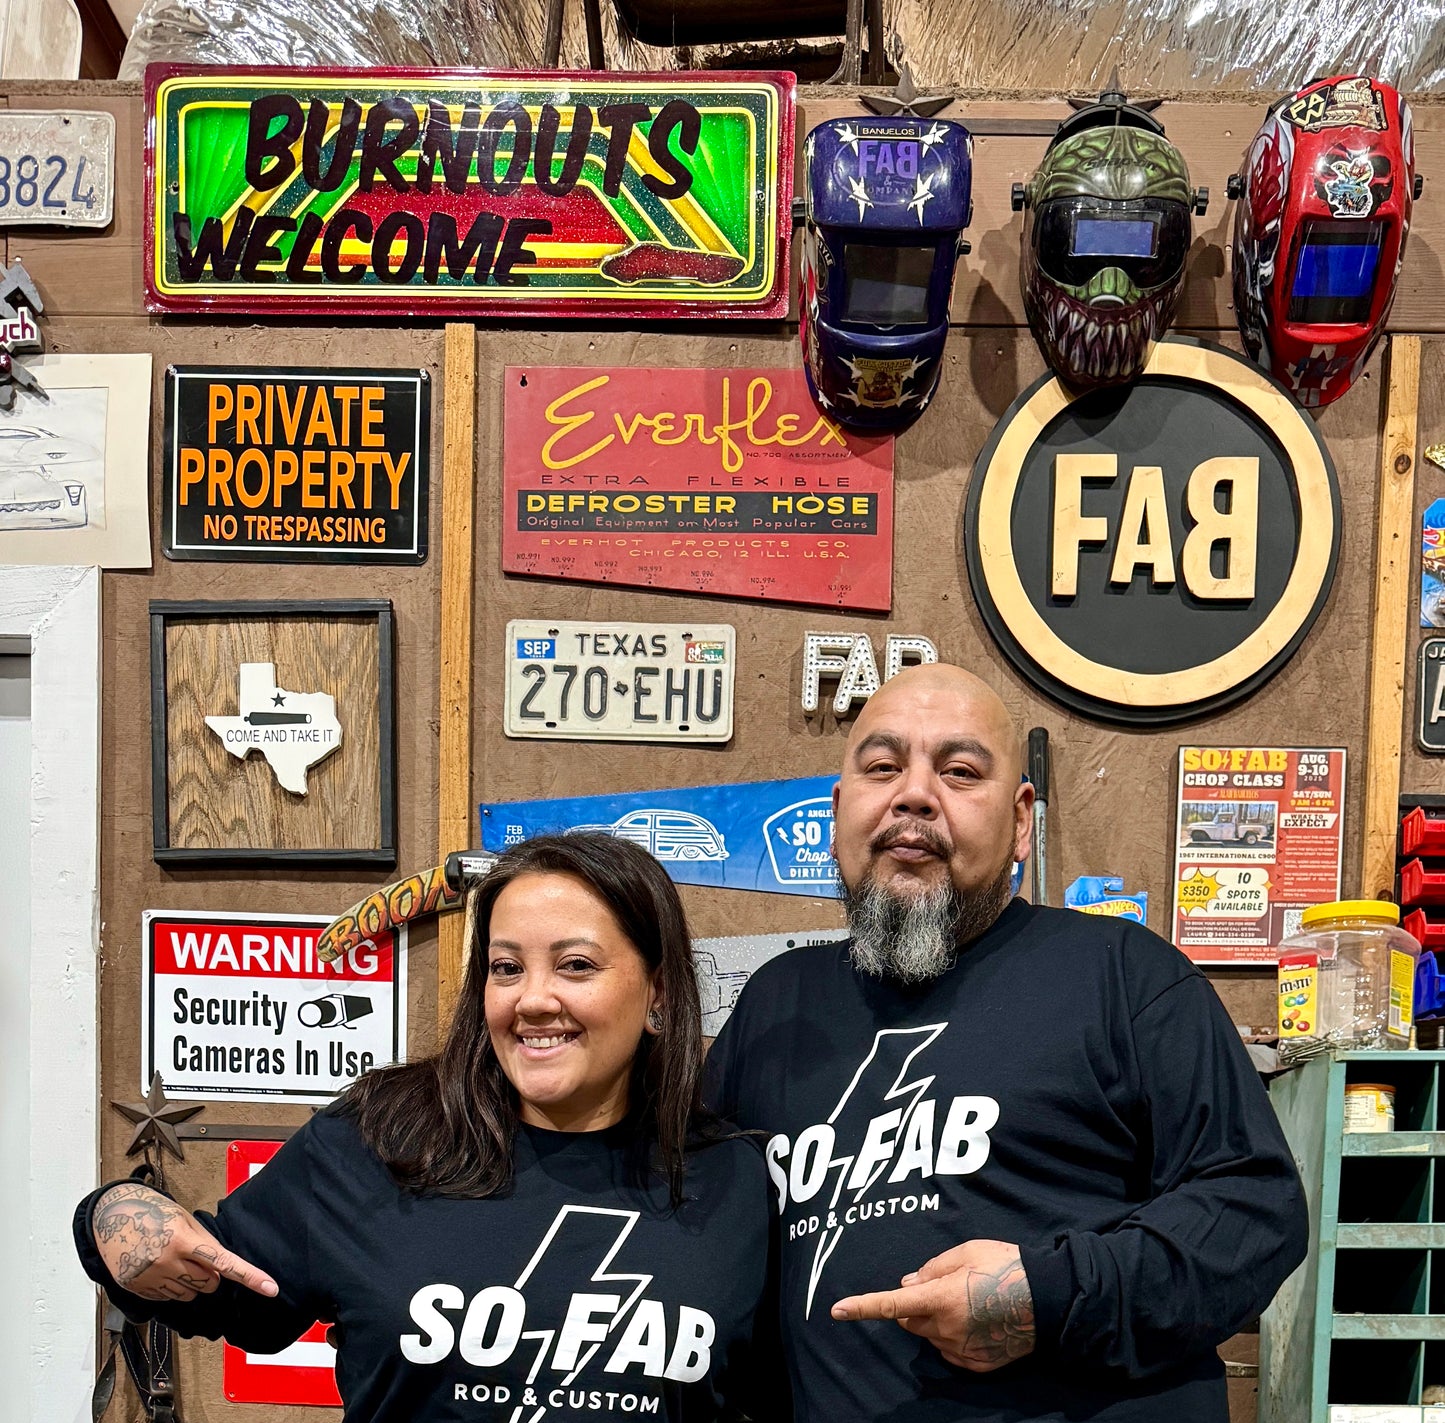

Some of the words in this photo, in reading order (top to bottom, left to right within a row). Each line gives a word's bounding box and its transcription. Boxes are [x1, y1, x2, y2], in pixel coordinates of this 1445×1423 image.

[862, 127, 915, 136] BANUELOS
[244, 94, 702, 199] BURNOUTS
[173, 206, 553, 285] WELCOME
[207, 384, 385, 447] PRIVATE
[541, 375, 847, 473] Everflex
[179, 448, 412, 510] PROPERTY
[541, 475, 649, 485] EXTRA
[687, 476, 850, 487] FLEXIBLE
[527, 494, 737, 514] DEFROSTER
[772, 496, 869, 515] HOSE
[203, 514, 238, 540] NO
[244, 515, 386, 543] TRESPASSING
[526, 516, 584, 529] Original
[595, 517, 668, 530] Equipment
[703, 517, 740, 529] Most
[753, 518, 817, 530] Popular
[831, 518, 868, 529] Cars
[541, 538, 643, 546] EVERHOT
[629, 549, 722, 560] CHICAGO,
[803, 551, 850, 559] U.S.A.
[523, 641, 551, 655] SEP
[575, 633, 667, 657] TEXAS
[519, 663, 608, 721] 270
[633, 667, 722, 723] EHU
[226, 729, 260, 743] COME
[263, 729, 287, 743] AND
[290, 729, 320, 743] TAKE
[323, 729, 333, 743] IT
[1184, 748, 1222, 771] SO
[1229, 748, 1288, 772] FAB
[1300, 754, 1328, 764] AUG.
[1298, 764, 1329, 776] 9-10
[1184, 773, 1228, 786] CHOP
[1232, 774, 1284, 787] CLASS
[1292, 790, 1332, 799] SAT/SUN
[506, 825, 523, 835] FEB
[1284, 819, 1328, 828] EXPECT
[504, 835, 525, 844] 2025
[792, 821, 821, 846] SO
[796, 848, 830, 866] Chop
[790, 868, 822, 878] DIRTY
[1237, 872, 1252, 884] 10
[1182, 885, 1210, 897] $350
[1226, 889, 1261, 899] SPOTS
[1213, 902, 1264, 911] AVAILABLE
[173, 988, 288, 1035] Security
[173, 1035, 286, 1075] Cameras
[296, 1040, 319, 1076] In
[329, 1041, 374, 1077] Use
[766, 1123, 835, 1215] SO
[847, 1095, 1000, 1190] FAB
[790, 1215, 820, 1241] ROD
[827, 1211, 838, 1228] &
[844, 1193, 940, 1224] CUSTOM
[399, 1283, 526, 1367] SO
[551, 1293, 716, 1383] FAB
[454, 1383, 511, 1403] ROD
[522, 1387, 538, 1406] &
[548, 1389, 660, 1414] CUSTOM
